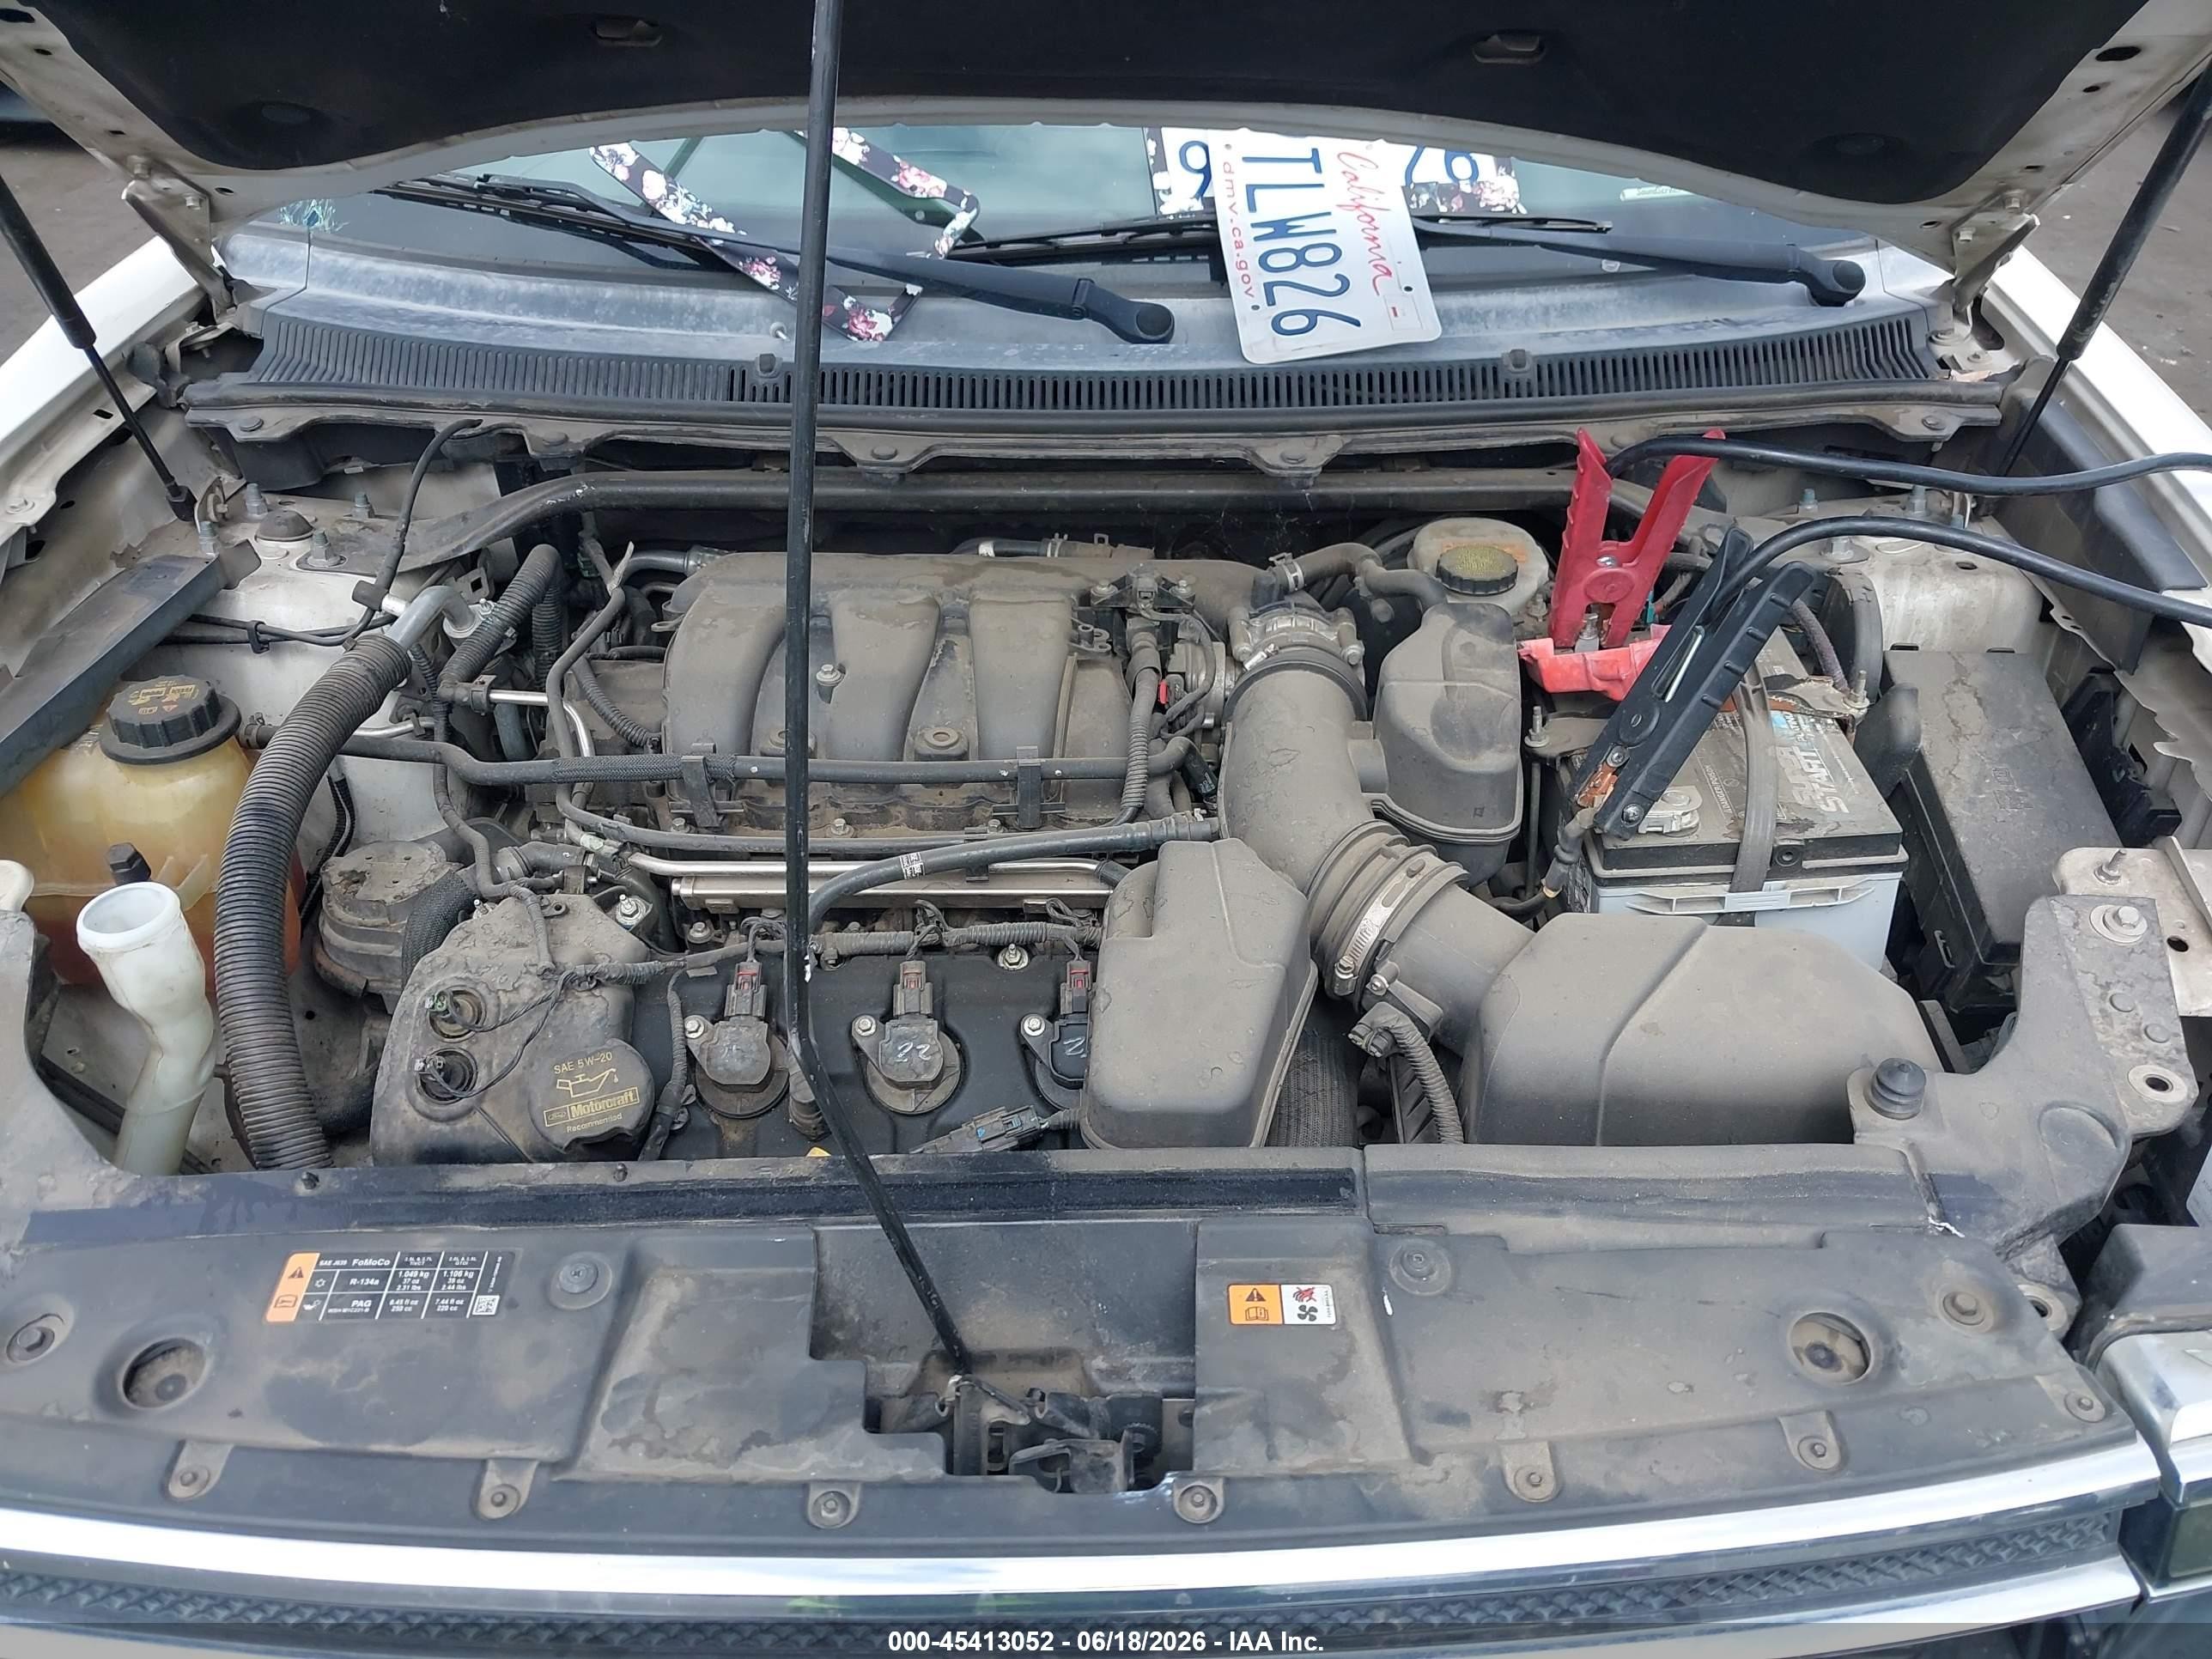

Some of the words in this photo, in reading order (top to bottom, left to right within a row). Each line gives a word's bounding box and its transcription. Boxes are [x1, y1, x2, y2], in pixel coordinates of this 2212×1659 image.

[1222, 161, 1255, 299] dmv.ca.gov
[1335, 151, 1396, 297] California
[1242, 148, 1362, 337] TLW826
[1791, 746, 1850, 814] START
[553, 1060, 575, 1075] SAE
[577, 1051, 613, 1069] 5W-20
[570, 1089, 635, 1119] Motorcraft
[566, 1112, 623, 1133] Recommended
[351, 1258, 391, 1267] FoMoCo
[419, 1270, 429, 1279] kg
[464, 1270, 474, 1279] kg
[350, 1299, 373, 1308] PAG
